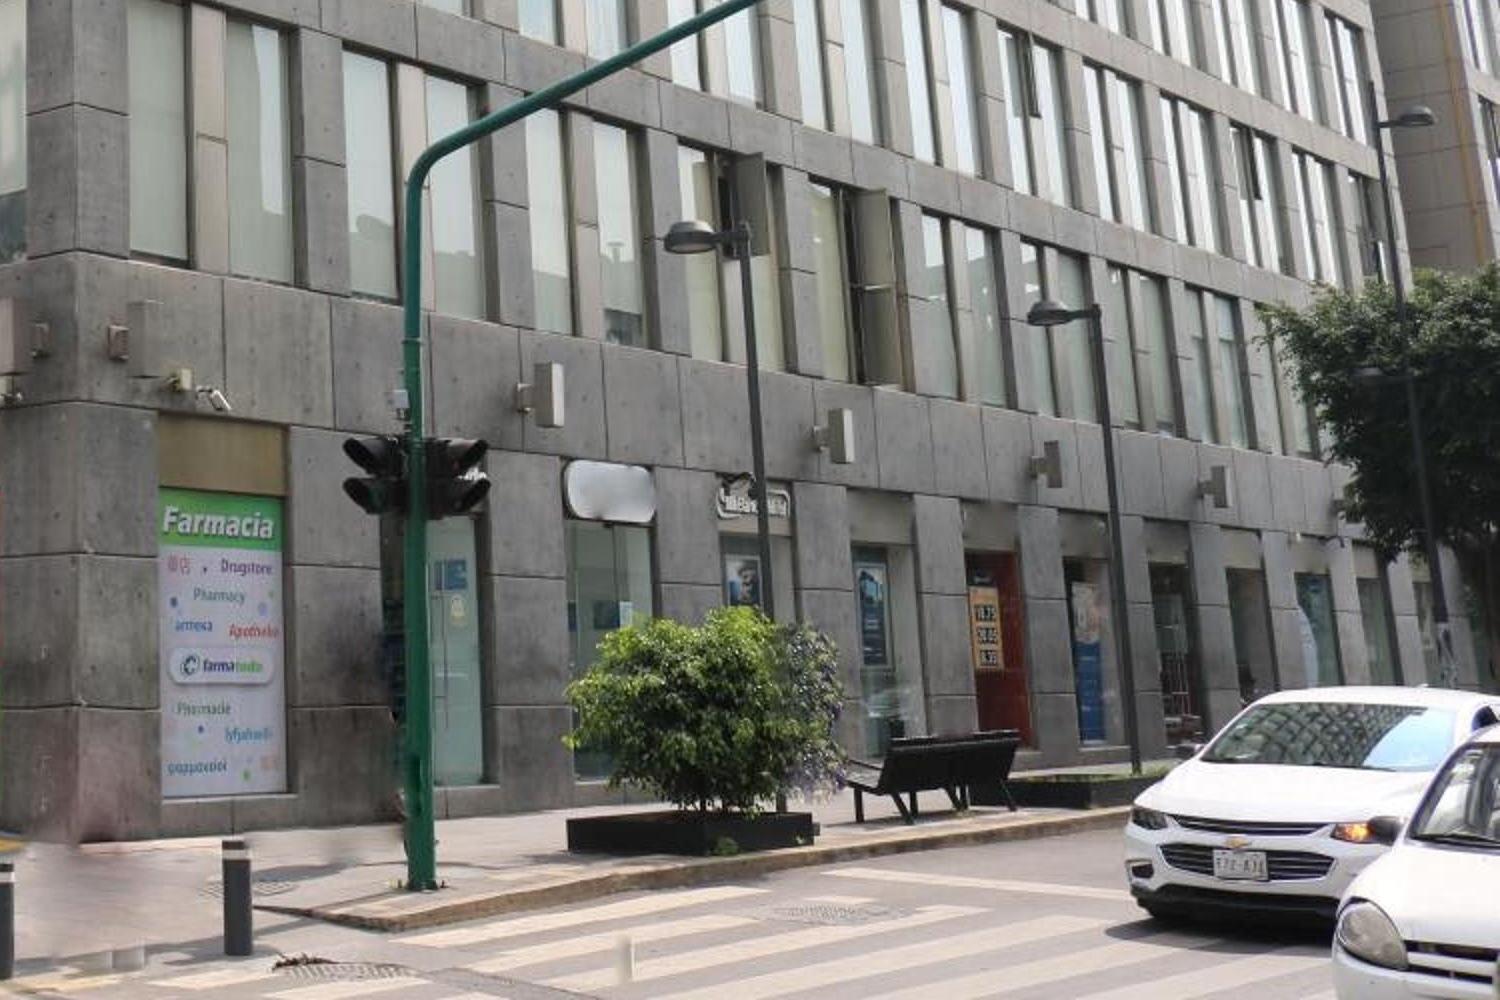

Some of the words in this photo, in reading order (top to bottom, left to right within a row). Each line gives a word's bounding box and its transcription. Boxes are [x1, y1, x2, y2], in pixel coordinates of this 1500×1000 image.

[163, 505, 274, 539] Farmacia
[220, 558, 273, 577] Drugstore
[193, 587, 245, 605] Pharmacy
[203, 659, 262, 673] farmatodo
